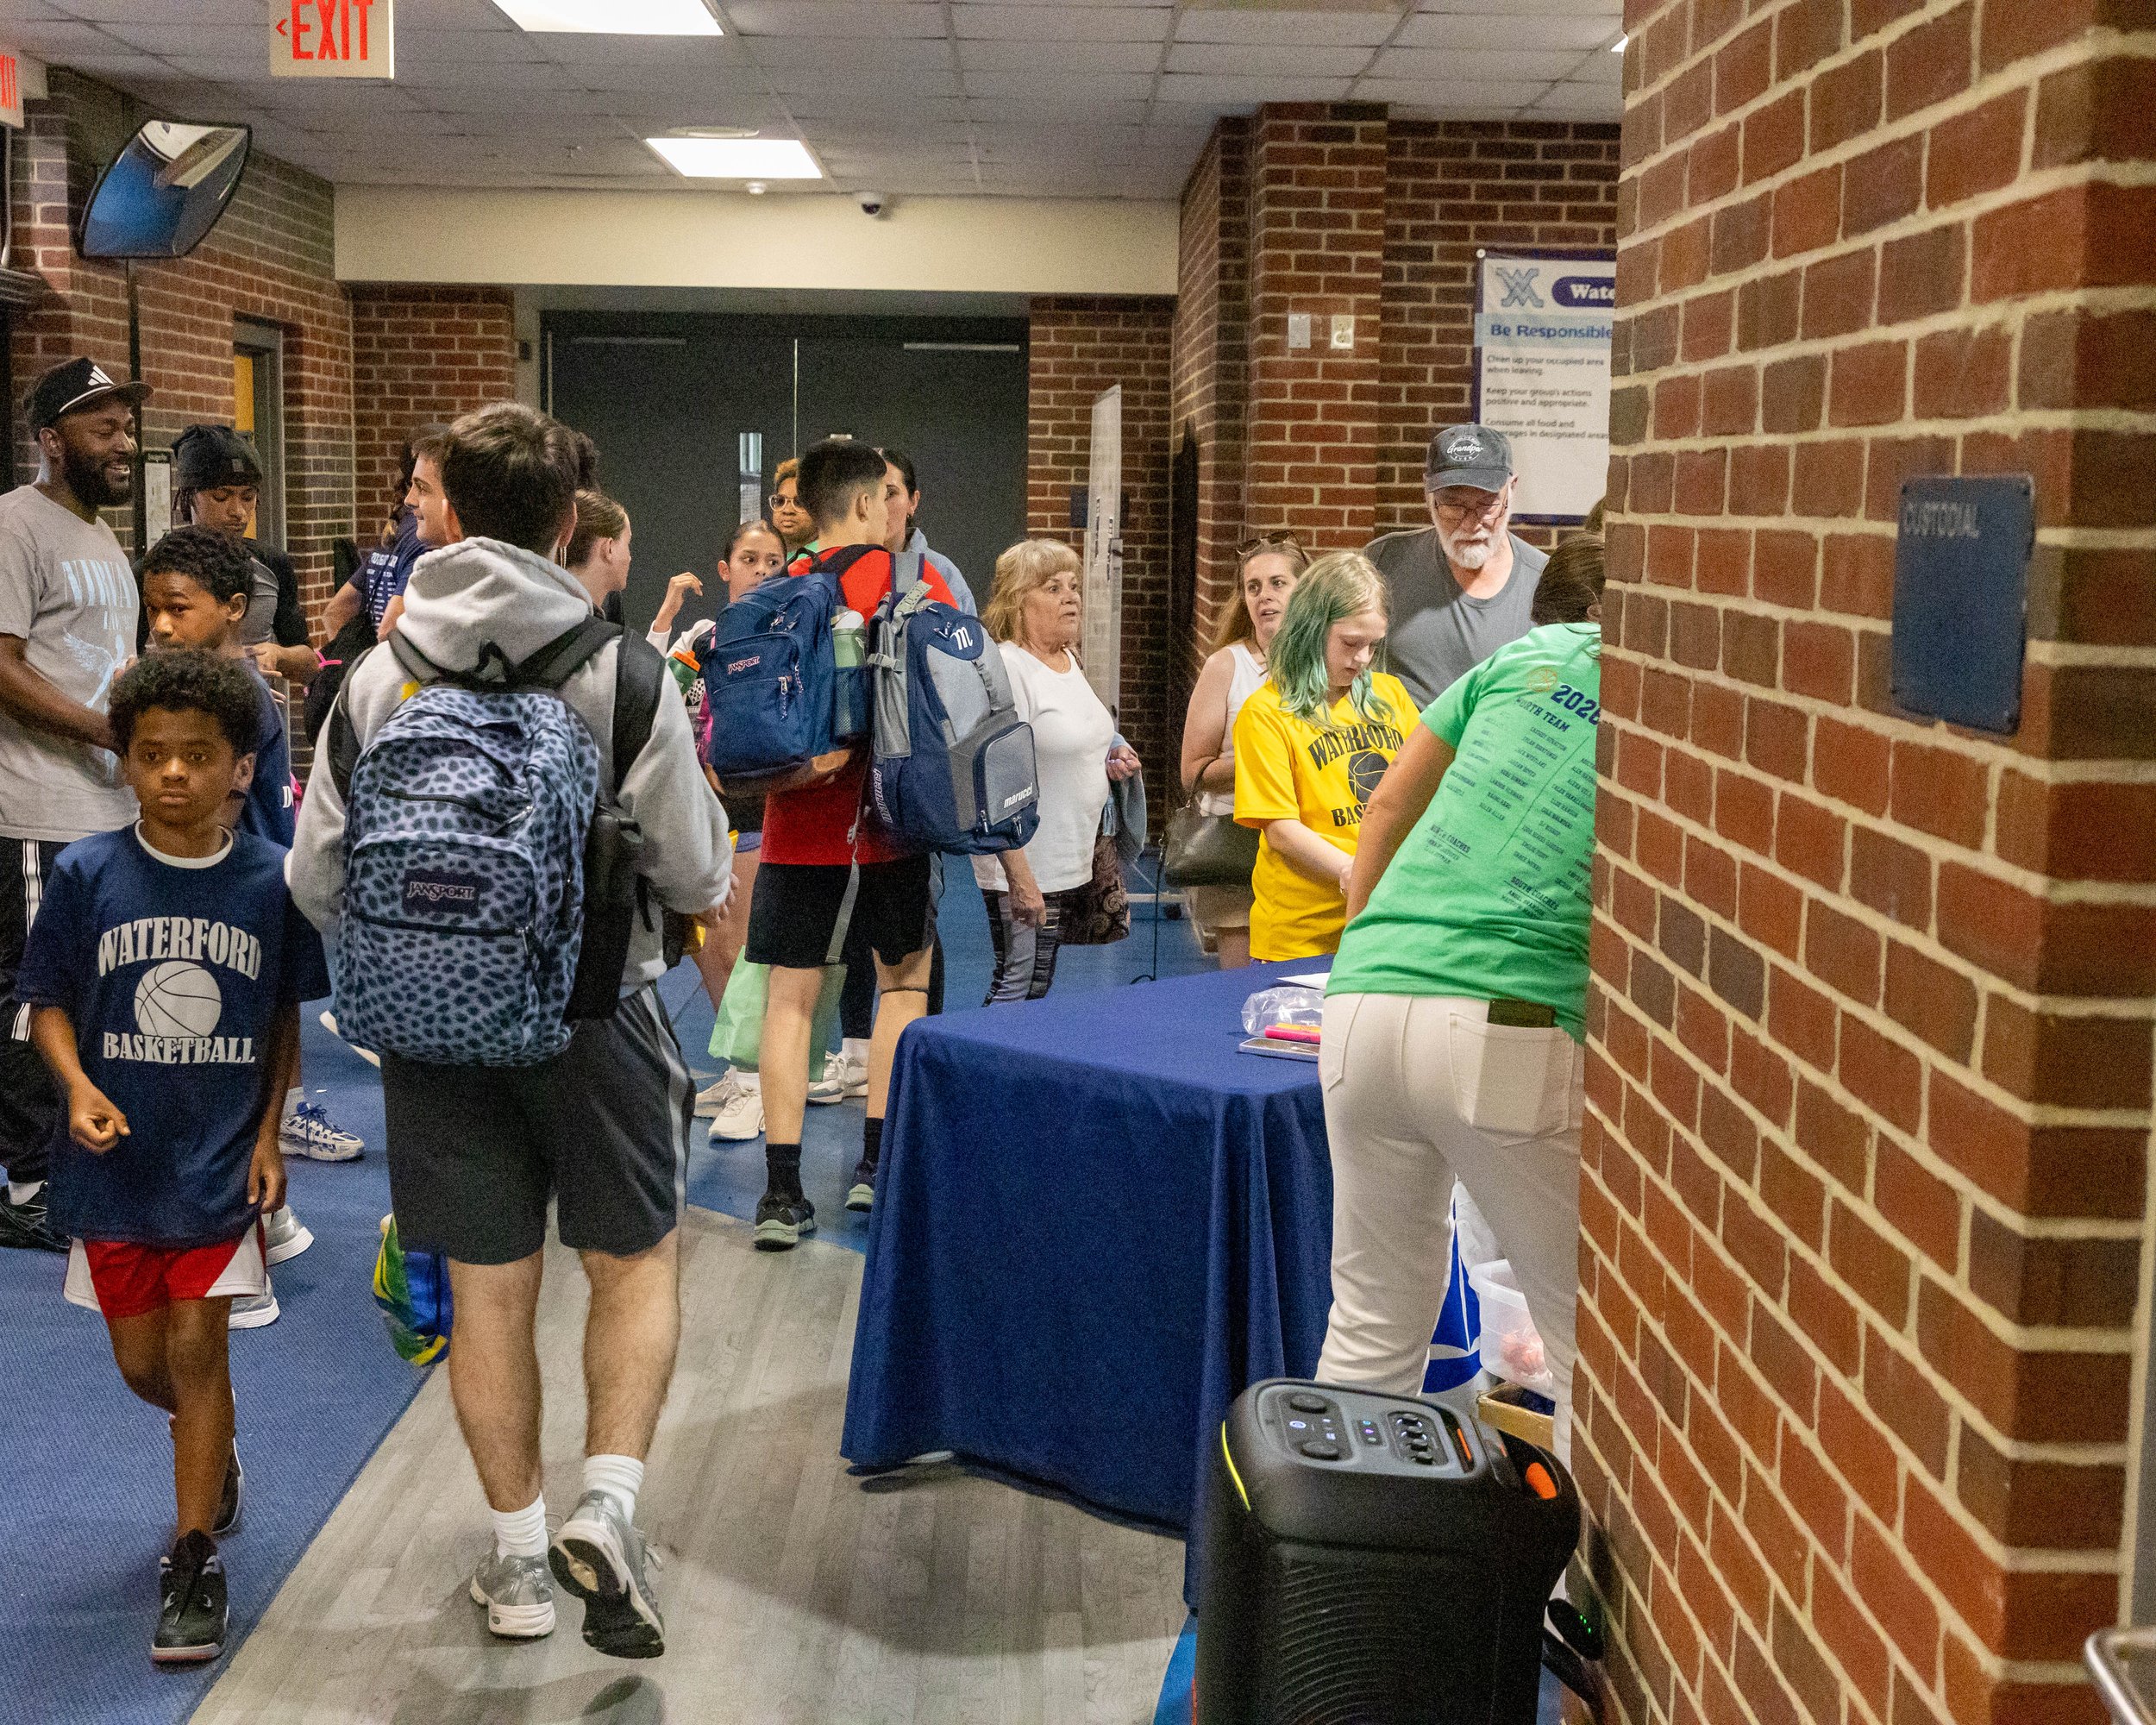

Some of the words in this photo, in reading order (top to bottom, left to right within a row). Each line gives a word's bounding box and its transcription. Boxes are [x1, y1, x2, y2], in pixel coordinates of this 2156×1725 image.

[291, 0, 373, 60] EXIT
[1490, 324, 1511, 336] Be
[1517, 324, 1612, 341] Responsible
[1487, 354, 1510, 363] Clean
[1526, 357, 1544, 366] your
[1546, 357, 1585, 367] occupied
[1485, 398, 1519, 406] positive
[1485, 417, 1524, 426] Consume
[1538, 419, 1557, 428] food
[1539, 431, 1586, 440] designated
[1446, 443, 1484, 454] Grandpa
[60, 559, 135, 608] NIRVA
[728, 656, 761, 674] JANSPORT
[1542, 712, 1570, 732] TEAM
[1307, 723, 1404, 771] WATERFORD
[1003, 782, 1033, 808] marucci
[1332, 804, 1367, 826] BAS
[407, 881, 476, 901] JANSPORT
[98, 917, 261, 981] WATERFORD
[103, 1032, 255, 1063] BASKETBALL
